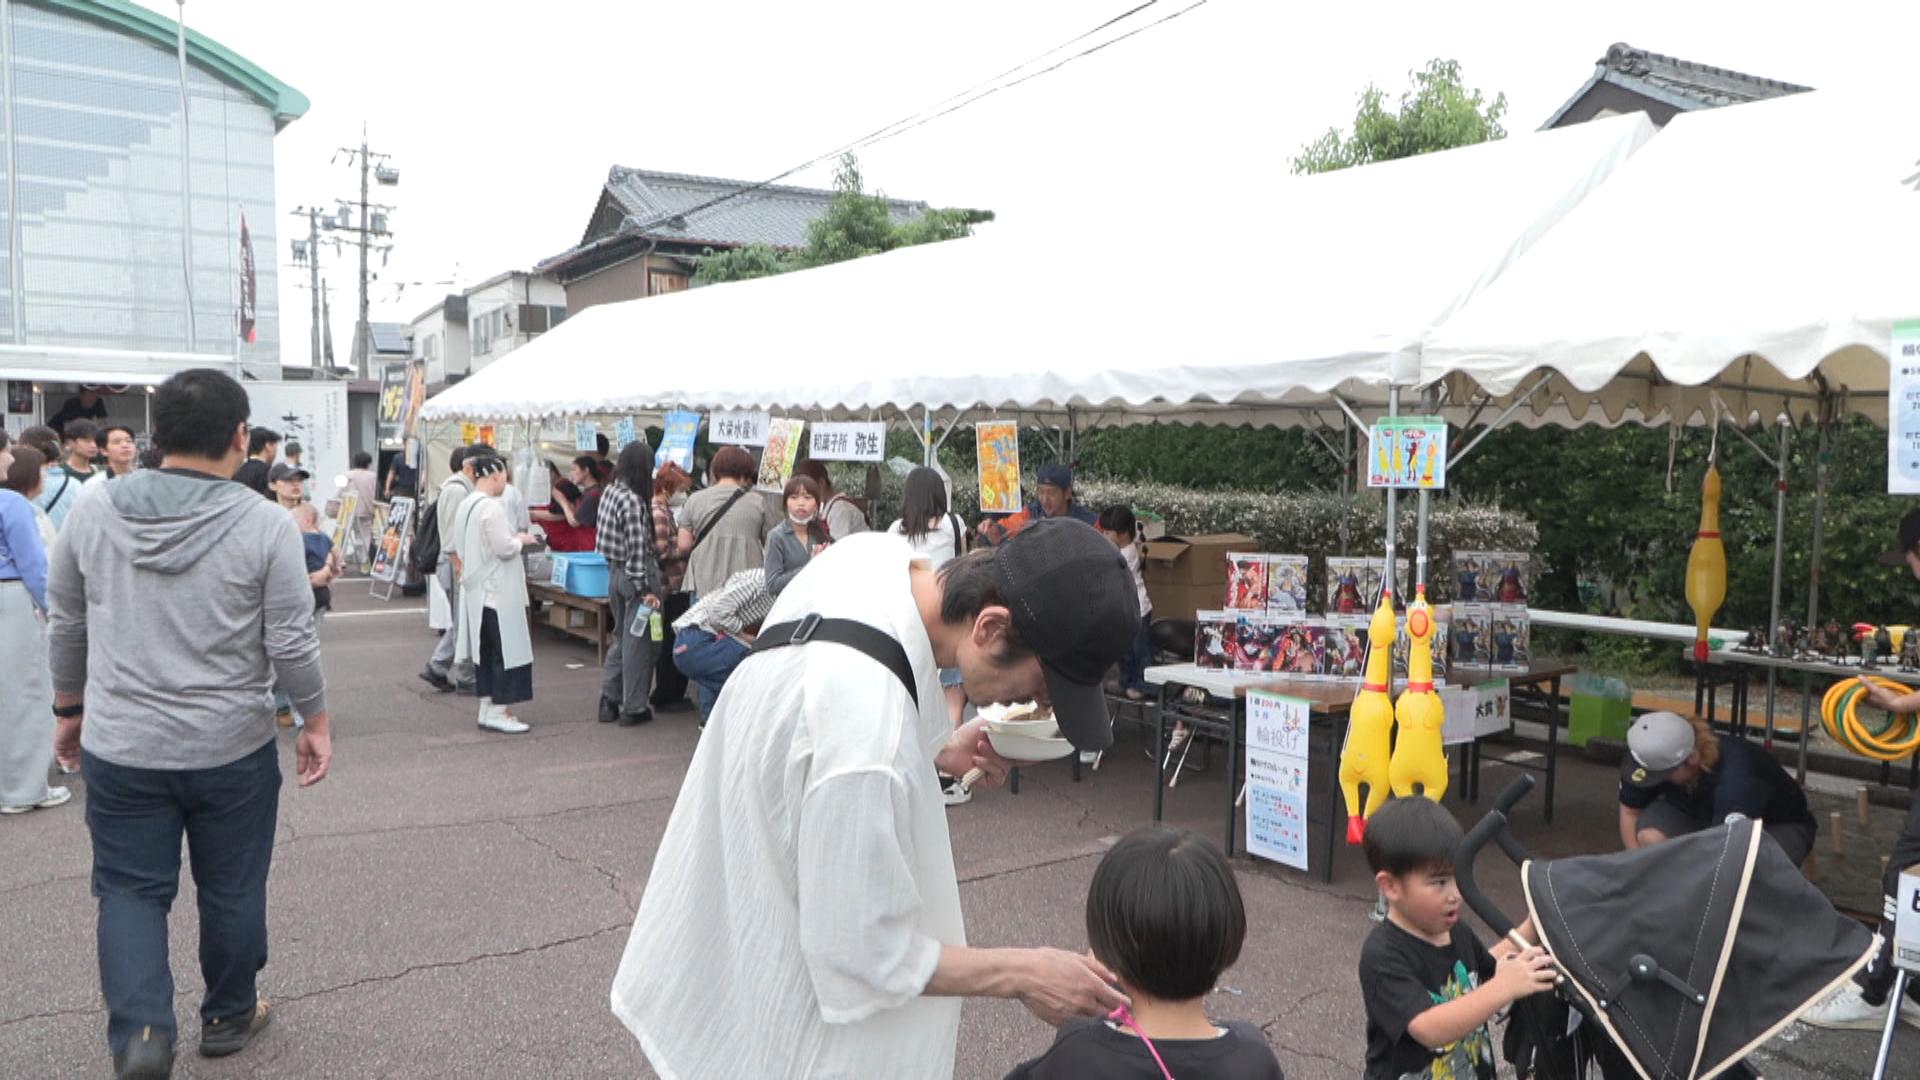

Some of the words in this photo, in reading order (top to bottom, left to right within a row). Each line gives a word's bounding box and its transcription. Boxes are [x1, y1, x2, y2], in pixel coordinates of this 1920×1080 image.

[814, 433, 848, 454] 和菓子所
[855, 431, 879, 456] 弥生
[1257, 724, 1298, 752] 輪投げ
